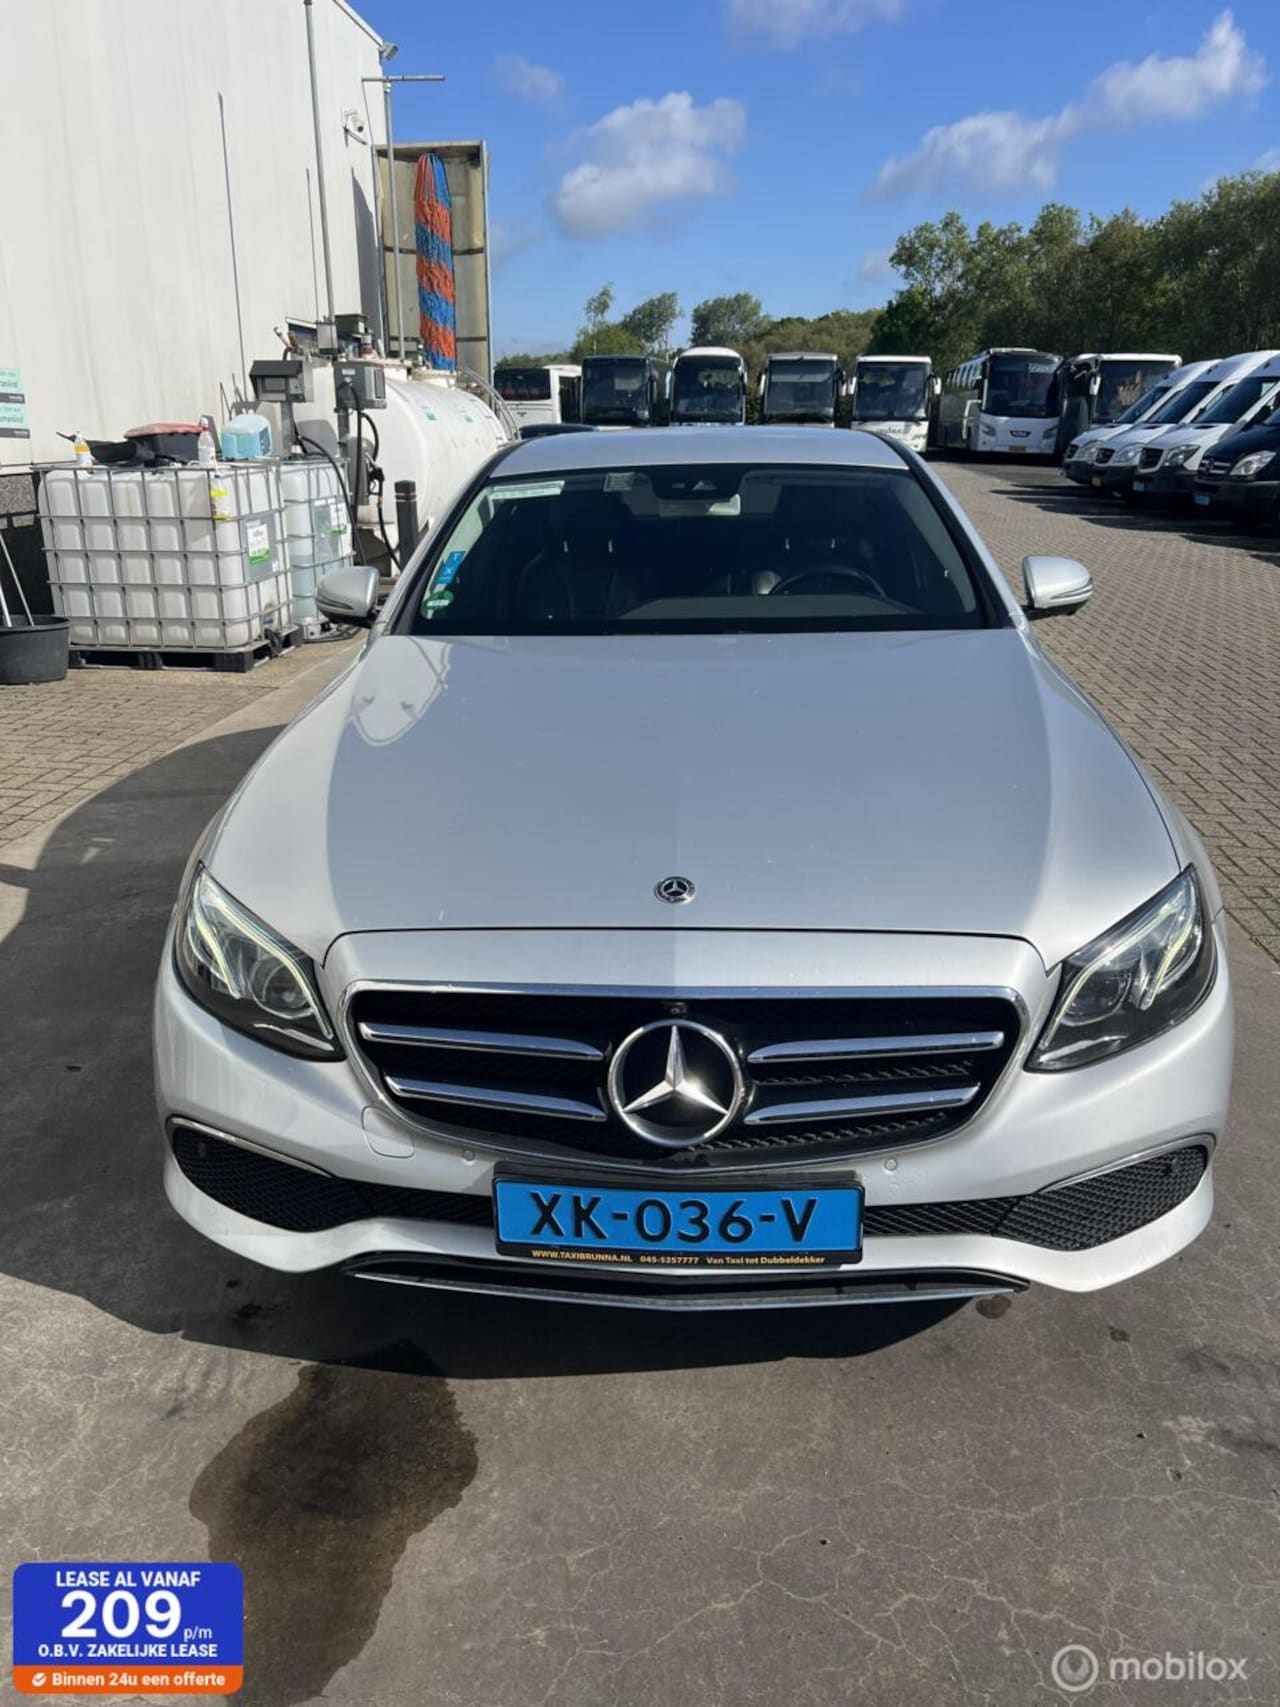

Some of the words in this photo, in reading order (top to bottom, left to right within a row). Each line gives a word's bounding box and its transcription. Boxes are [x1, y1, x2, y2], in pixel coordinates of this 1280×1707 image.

[529, 1190, 818, 1243] XK-036-V
[531, 1250, 632, 1263] WWW.TAXIBRUNNA.NL
[705, 1257, 724, 1265] Van
[726, 1256, 744, 1265] Taxi
[745, 1257, 758, 1265] tot
[760, 1256, 826, 1265] Dubbeldekker
